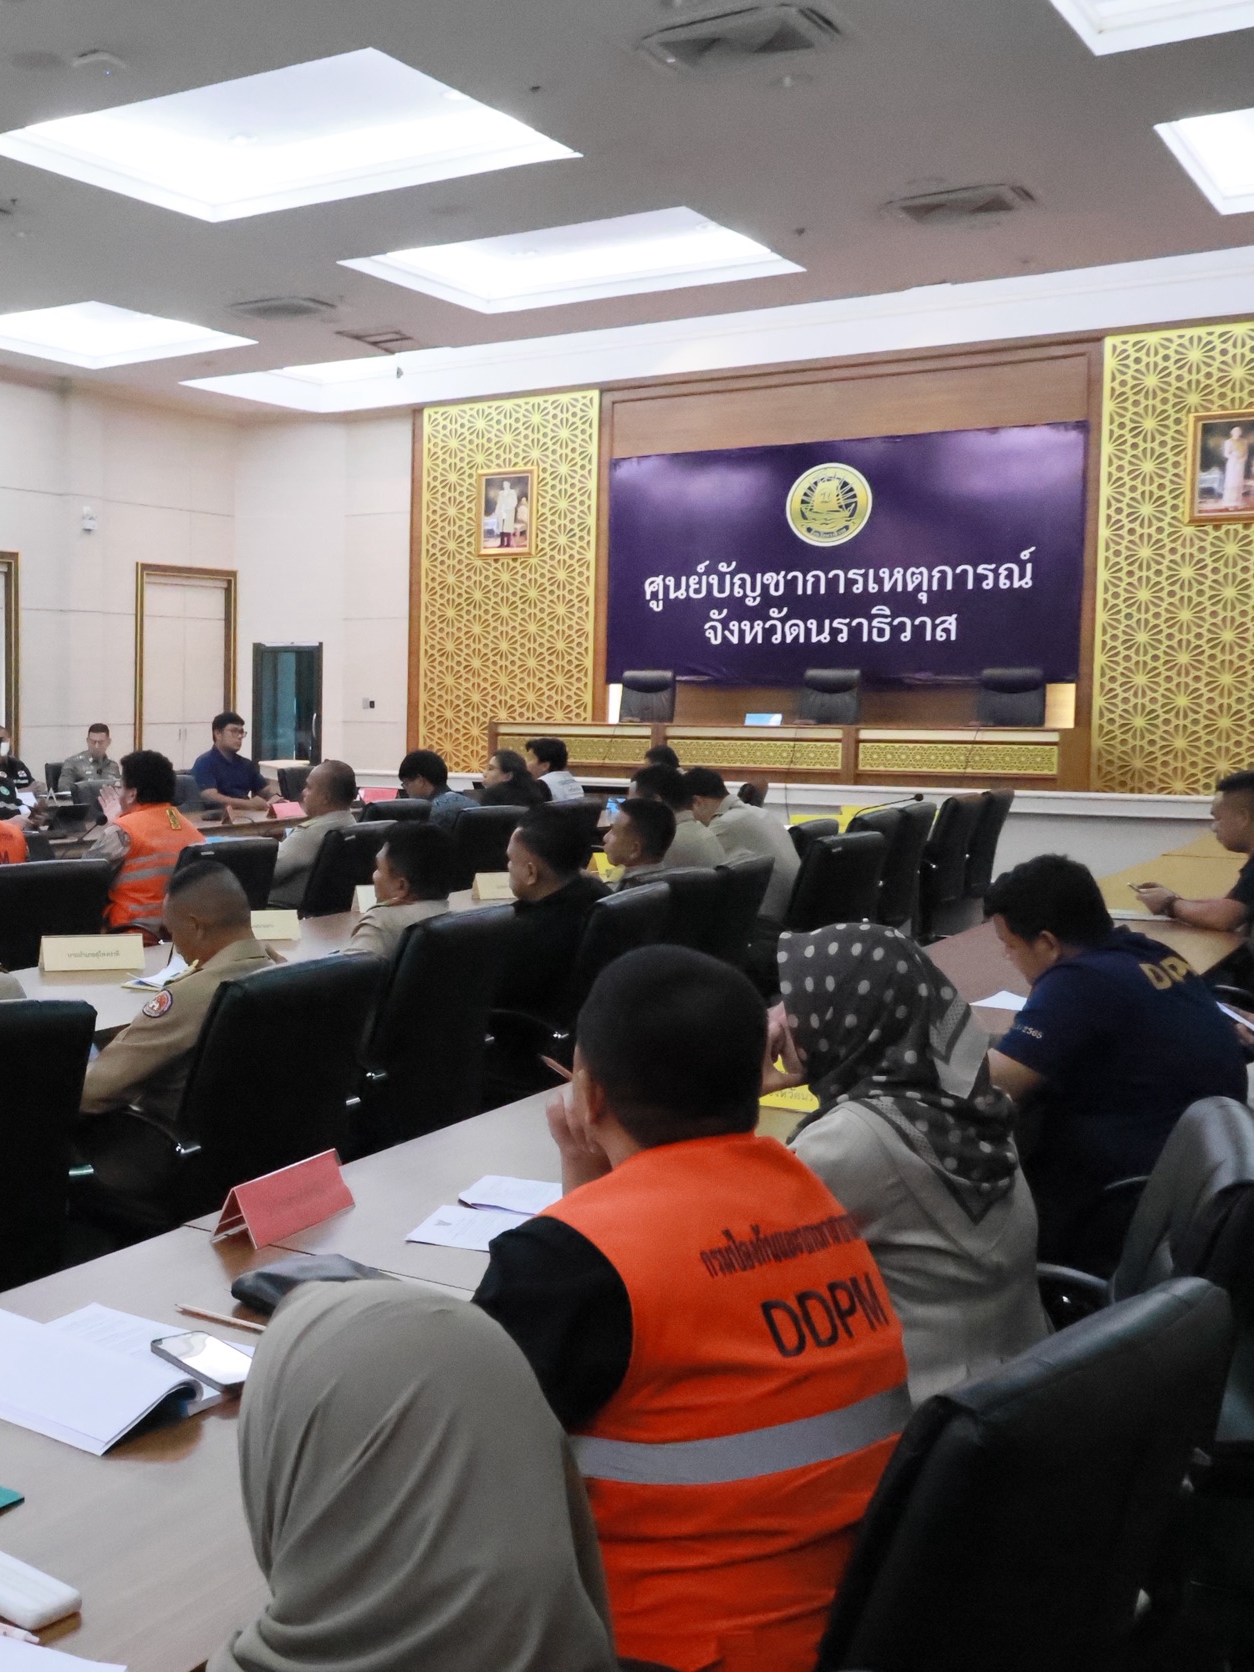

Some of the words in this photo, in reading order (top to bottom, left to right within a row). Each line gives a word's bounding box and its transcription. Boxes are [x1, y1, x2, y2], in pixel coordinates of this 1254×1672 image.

[644, 546, 1036, 612] ศูนย์บัญชาการเหตุการณ์
[703, 606, 958, 646] จังหวัดนราธิวาส
[761, 1273, 889, 1358] DDPM
